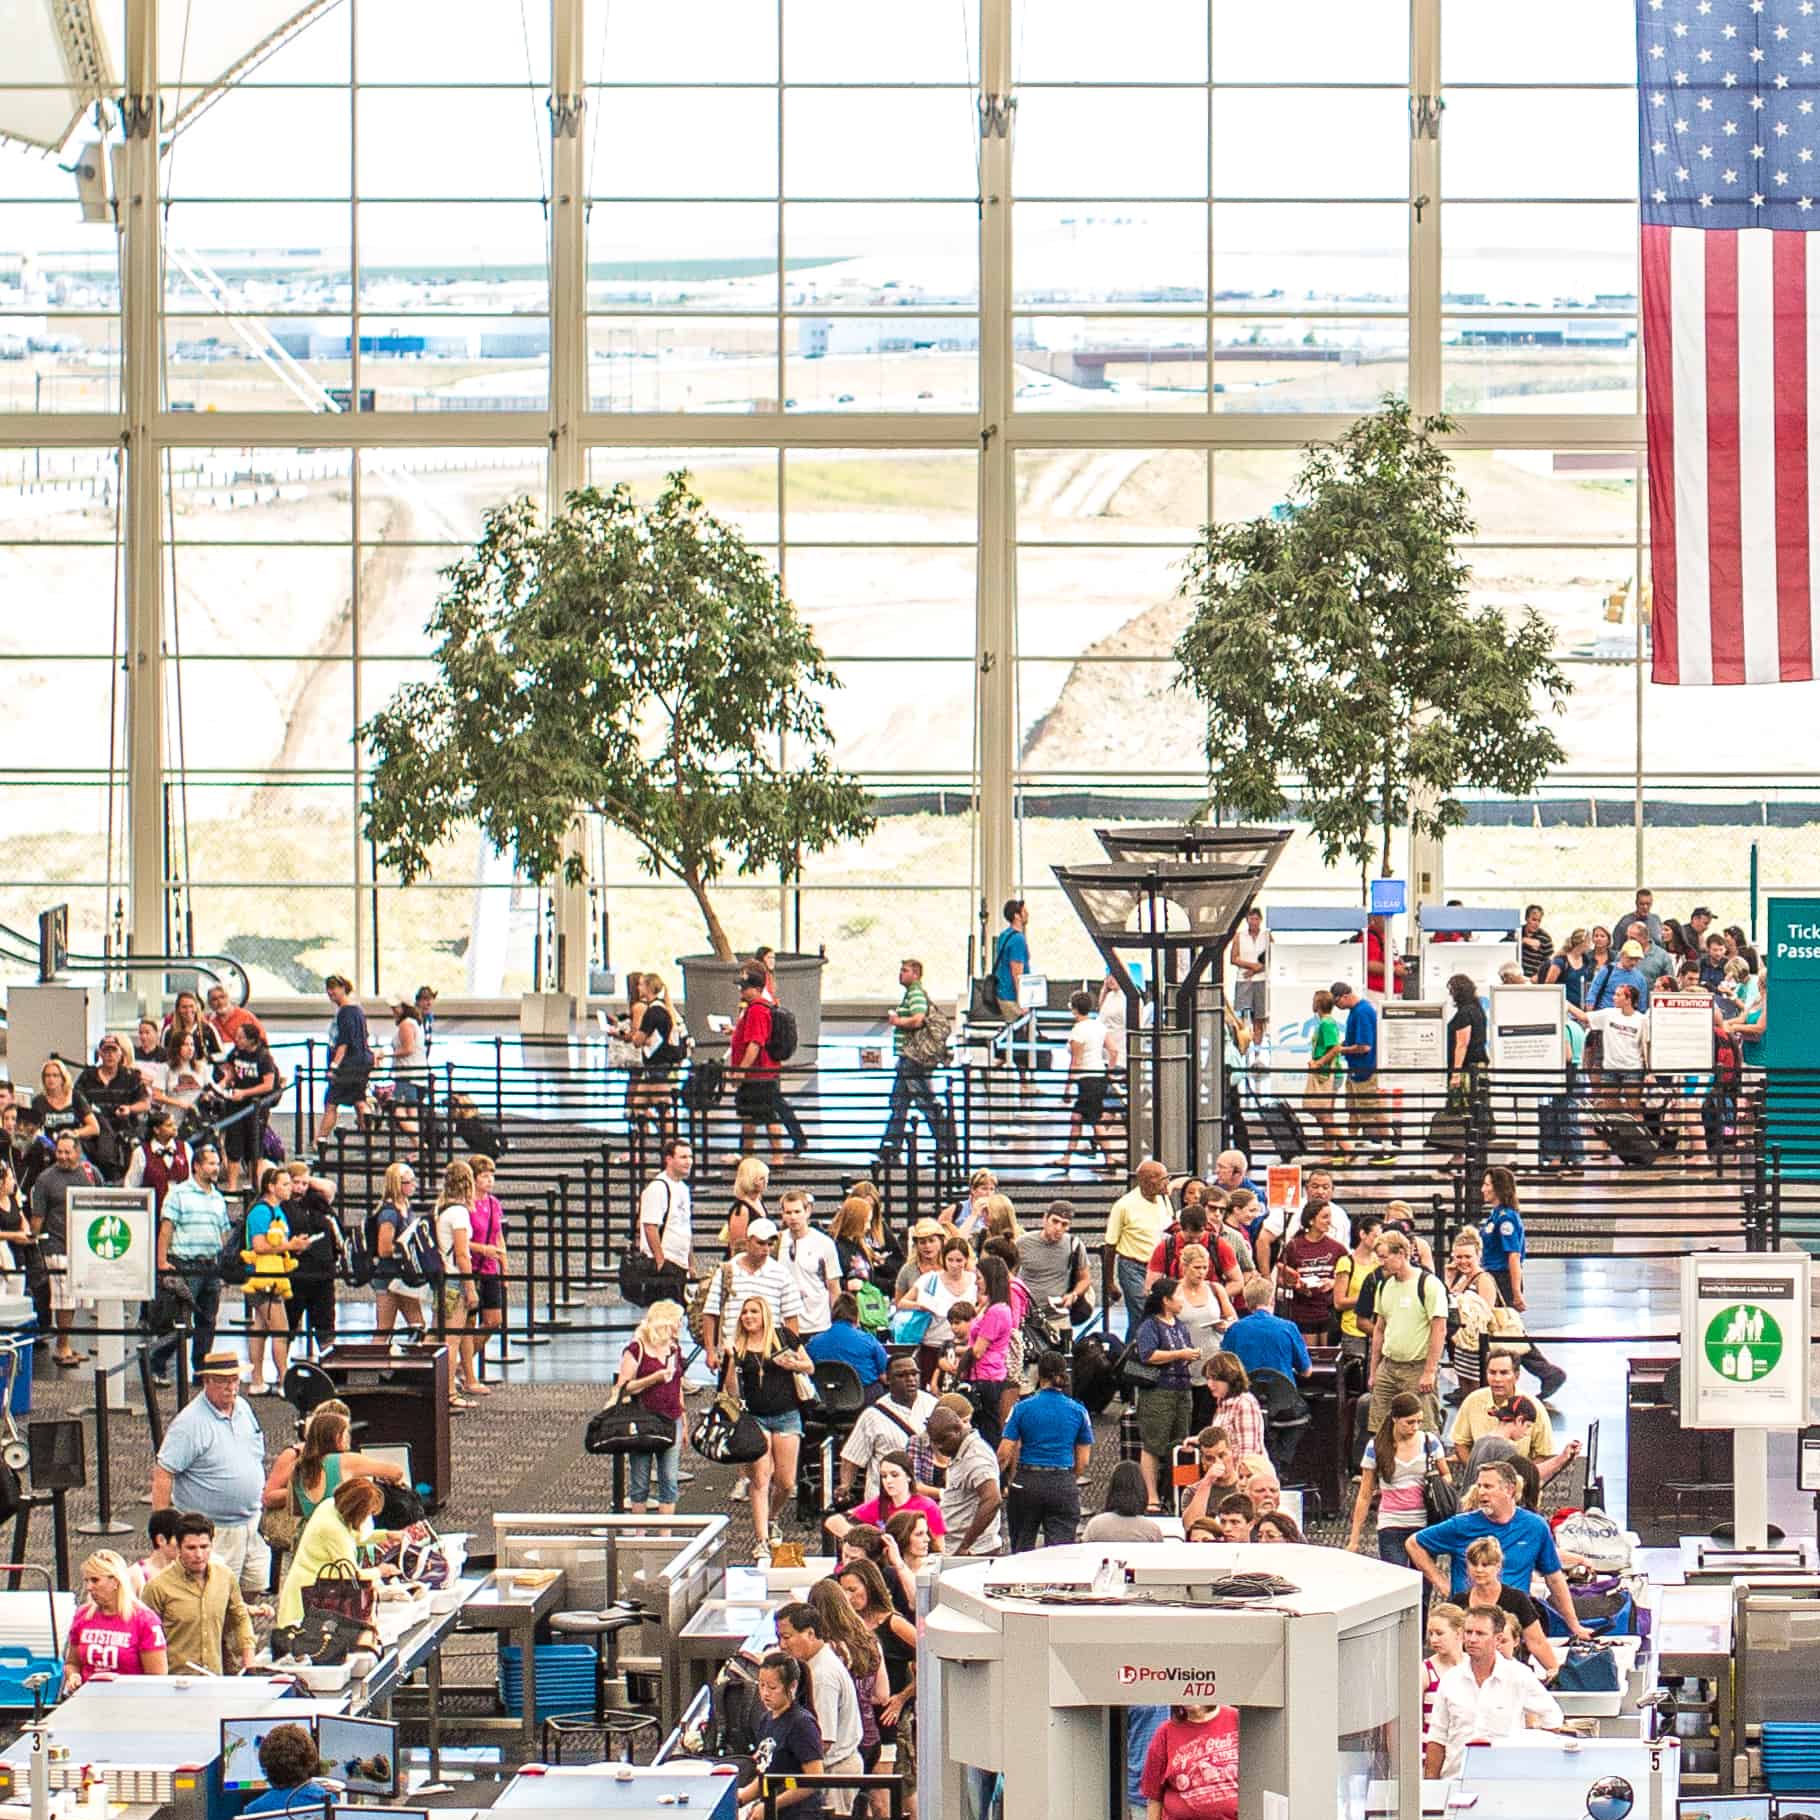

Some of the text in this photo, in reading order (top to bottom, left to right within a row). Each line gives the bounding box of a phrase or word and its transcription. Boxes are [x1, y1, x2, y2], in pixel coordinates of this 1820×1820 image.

[1666, 999, 1710, 1009] ATTENTION
[1139, 1667, 1217, 1681] ProVision
[1183, 1683, 1217, 1697] ATD
[32, 1732, 41, 1752] 3
[1651, 1751, 1660, 1771] 5
